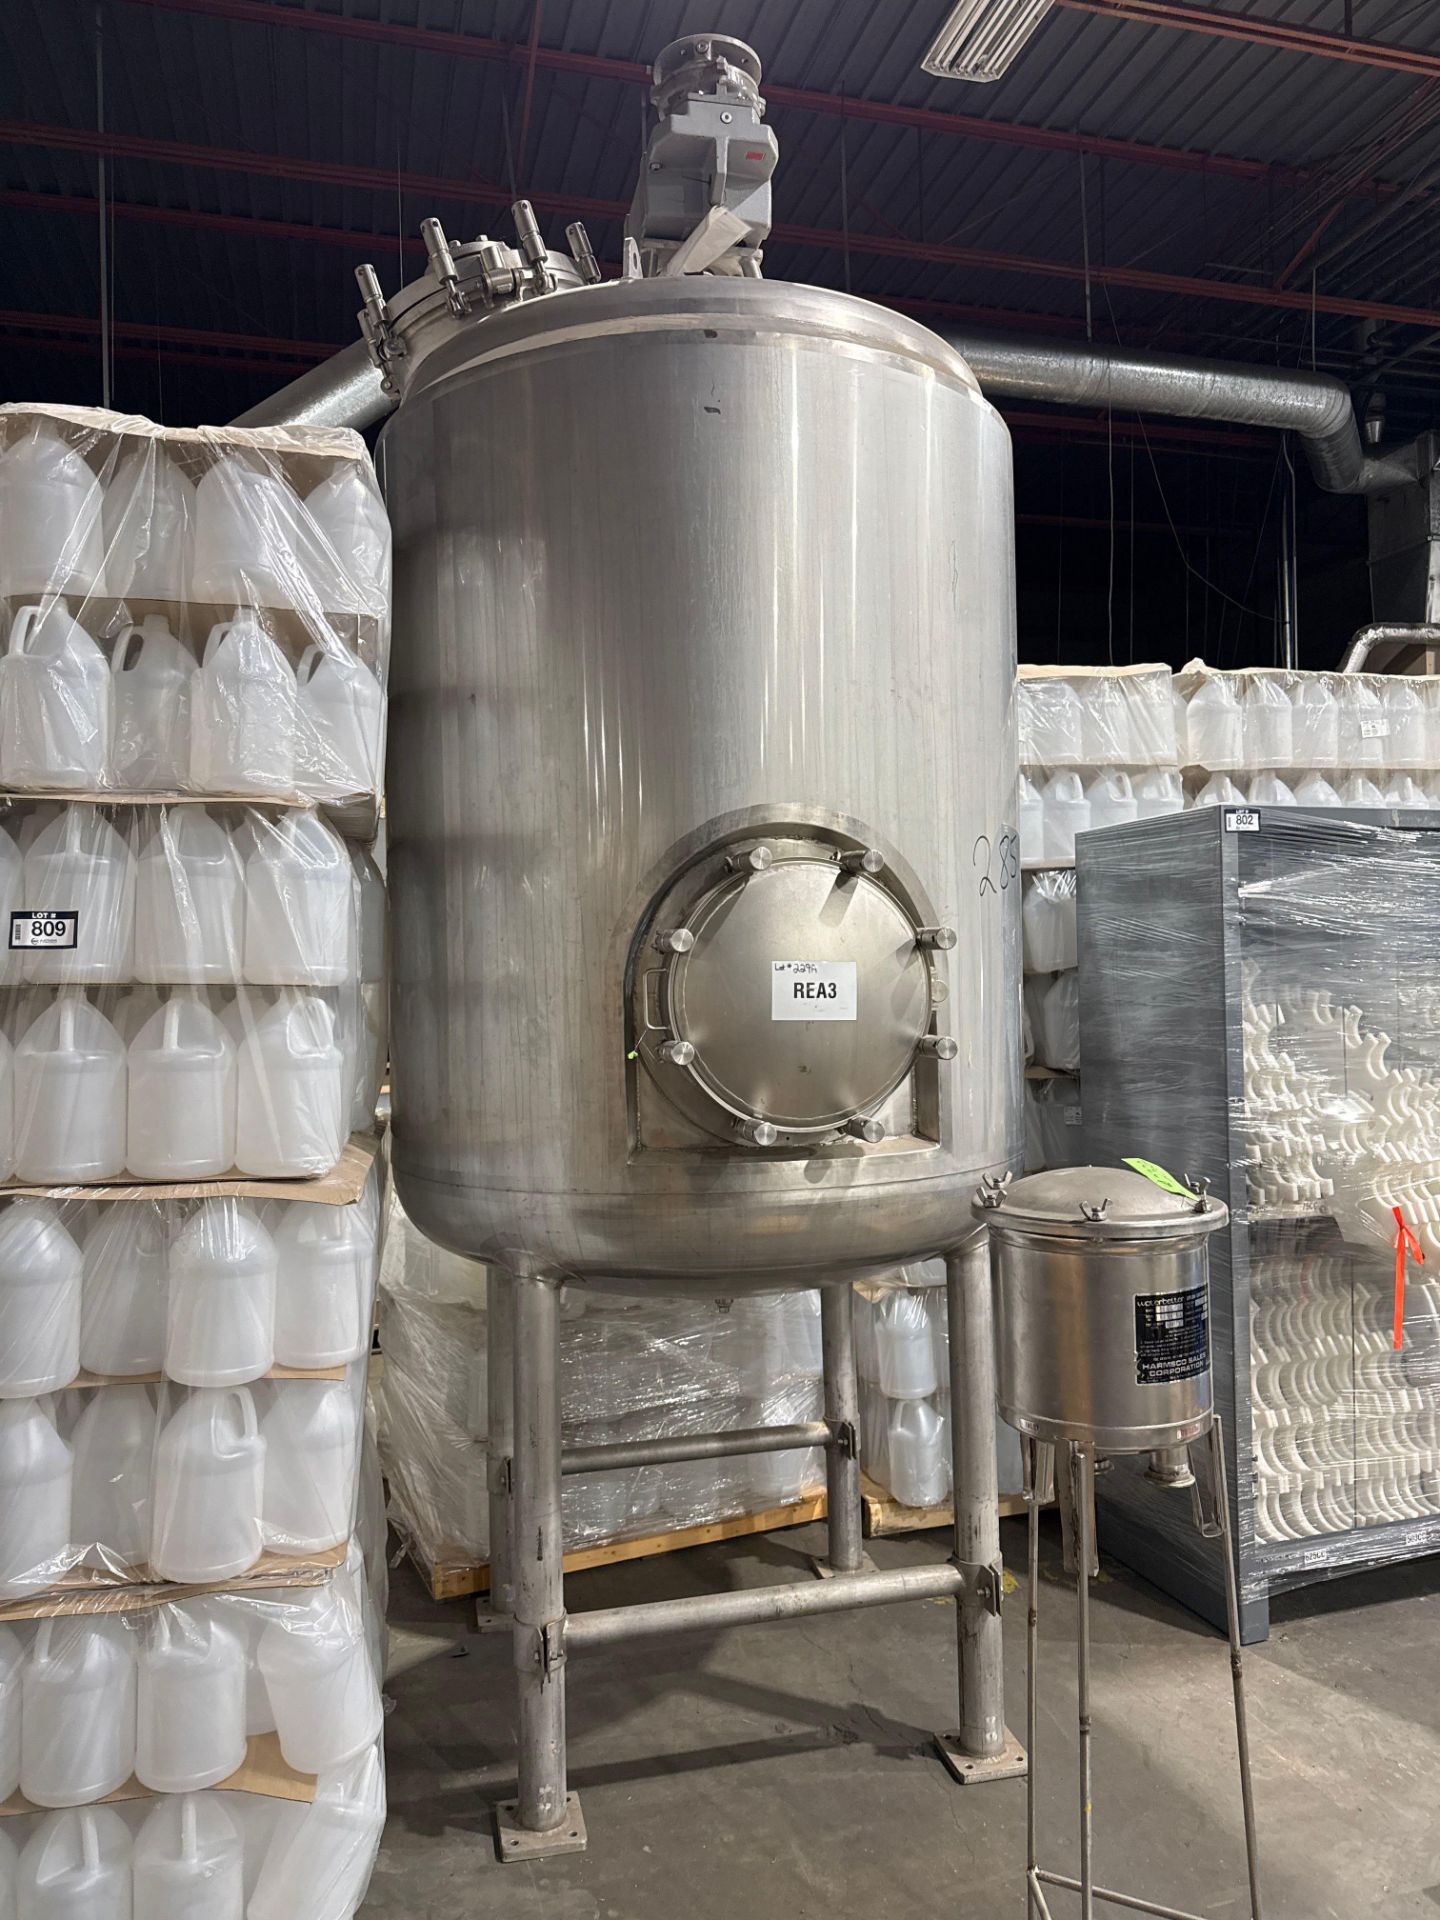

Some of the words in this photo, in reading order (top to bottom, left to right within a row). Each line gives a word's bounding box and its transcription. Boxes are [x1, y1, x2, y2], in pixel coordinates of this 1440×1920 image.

[1236, 815, 1254, 825] 802
[31, 921, 66, 936] 809
[793, 982, 837, 999] REA3
[1142, 1358, 1187, 1370] HARMSCO
[1188, 1352, 1206, 1364] SALES
[1149, 1360, 1204, 1377] CORPORATION
